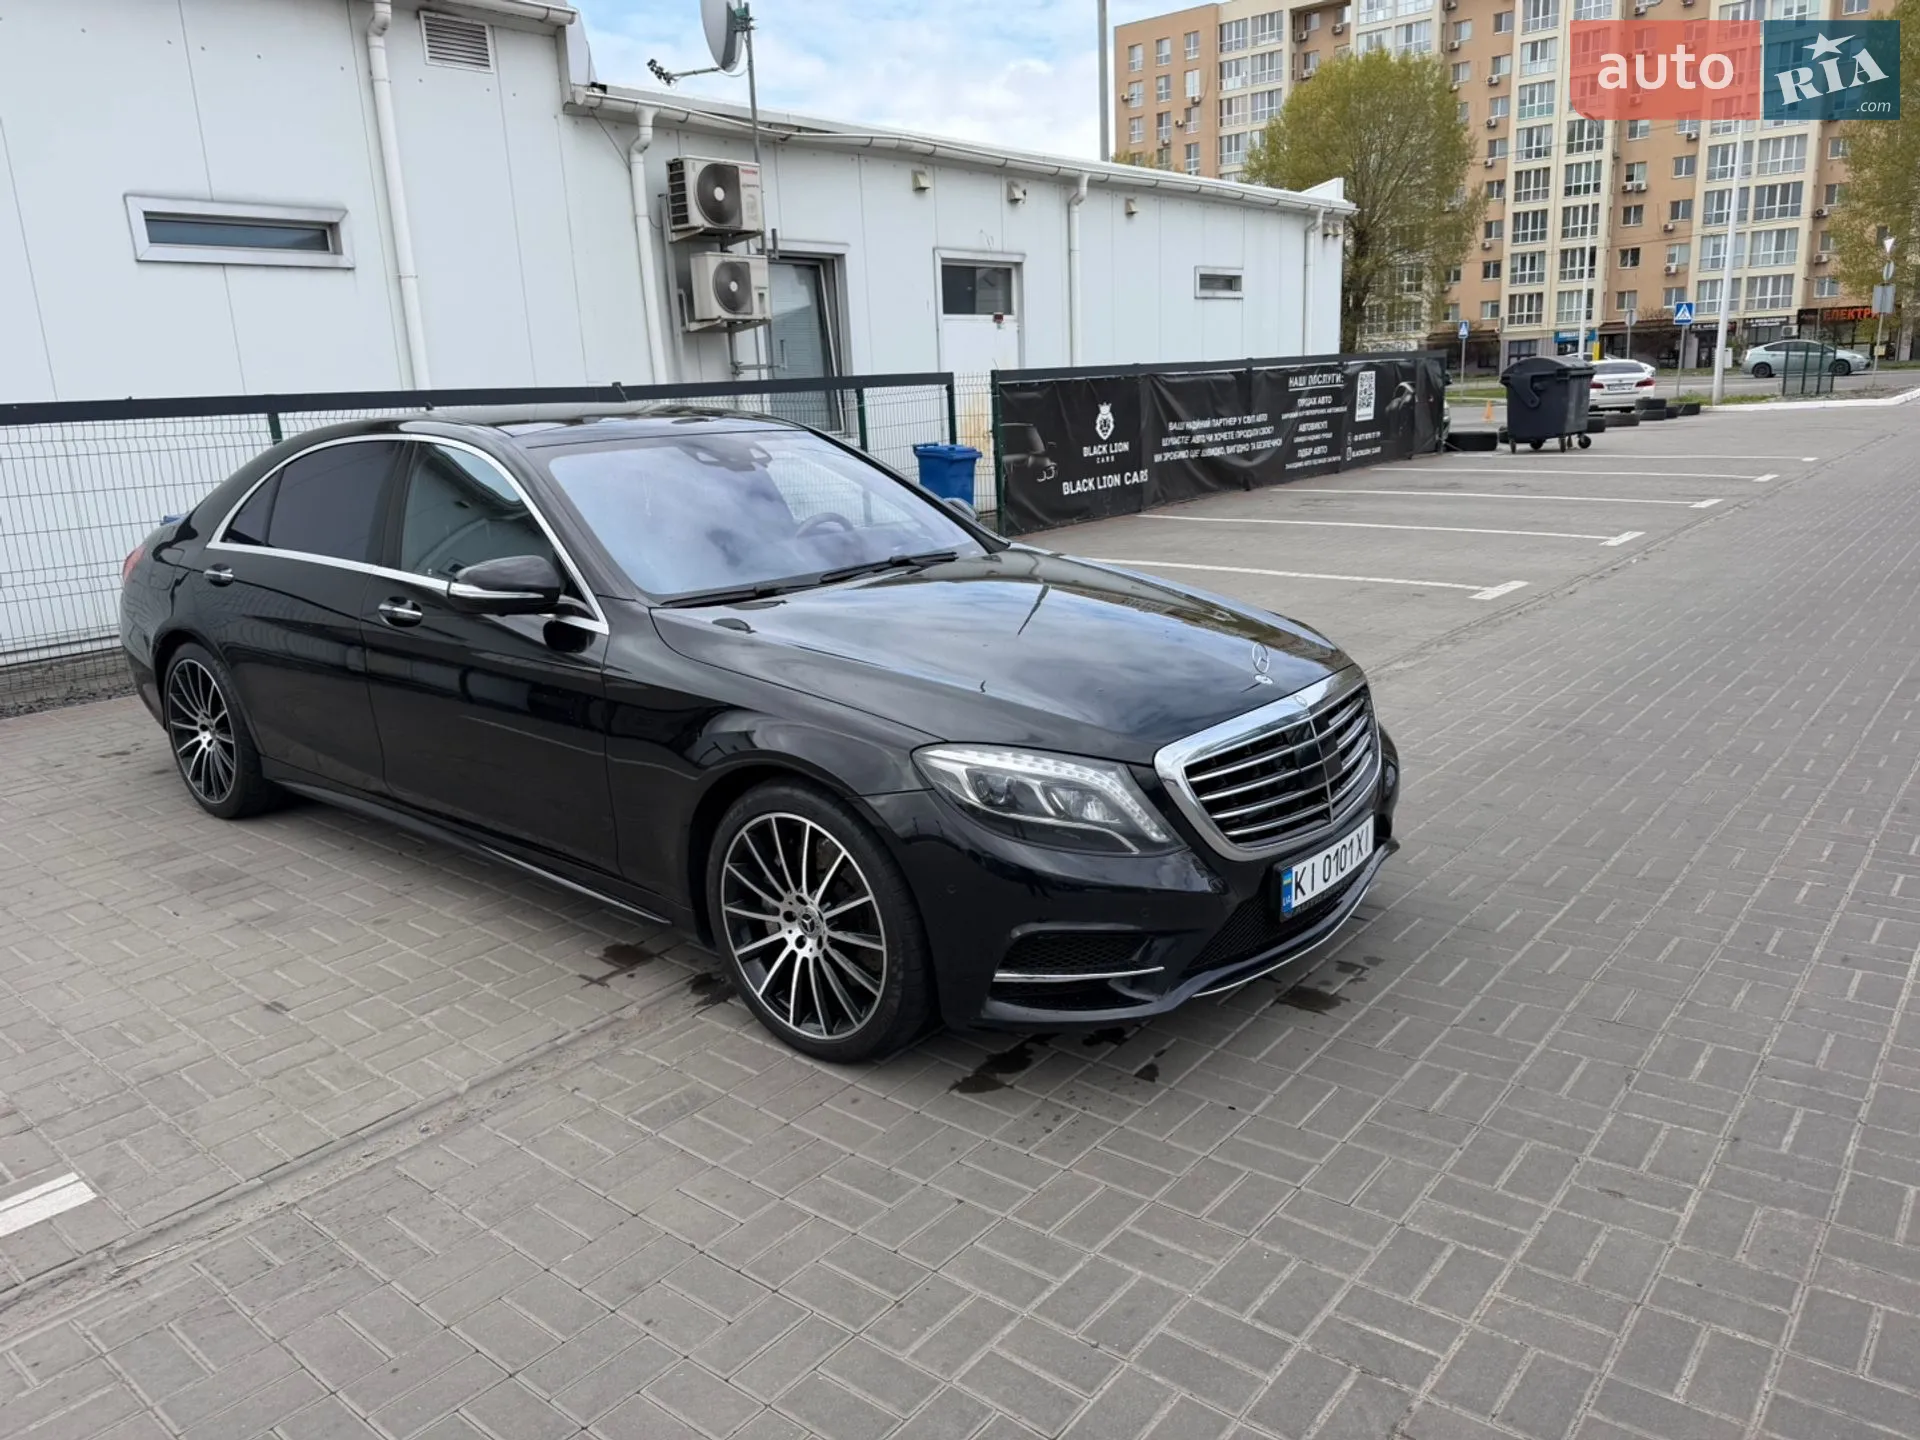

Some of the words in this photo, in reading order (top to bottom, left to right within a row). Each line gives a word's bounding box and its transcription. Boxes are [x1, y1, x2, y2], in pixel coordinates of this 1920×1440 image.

[1082, 443, 1108, 458] BLACK
[1109, 441, 1129, 455] LION
[1062, 478, 1095, 495] BLACK
[1097, 474, 1121, 489] LION
[1124, 469, 1148, 486] CARS
[1294, 862, 1315, 900] KI
[1322, 838, 1354, 883] 0101
